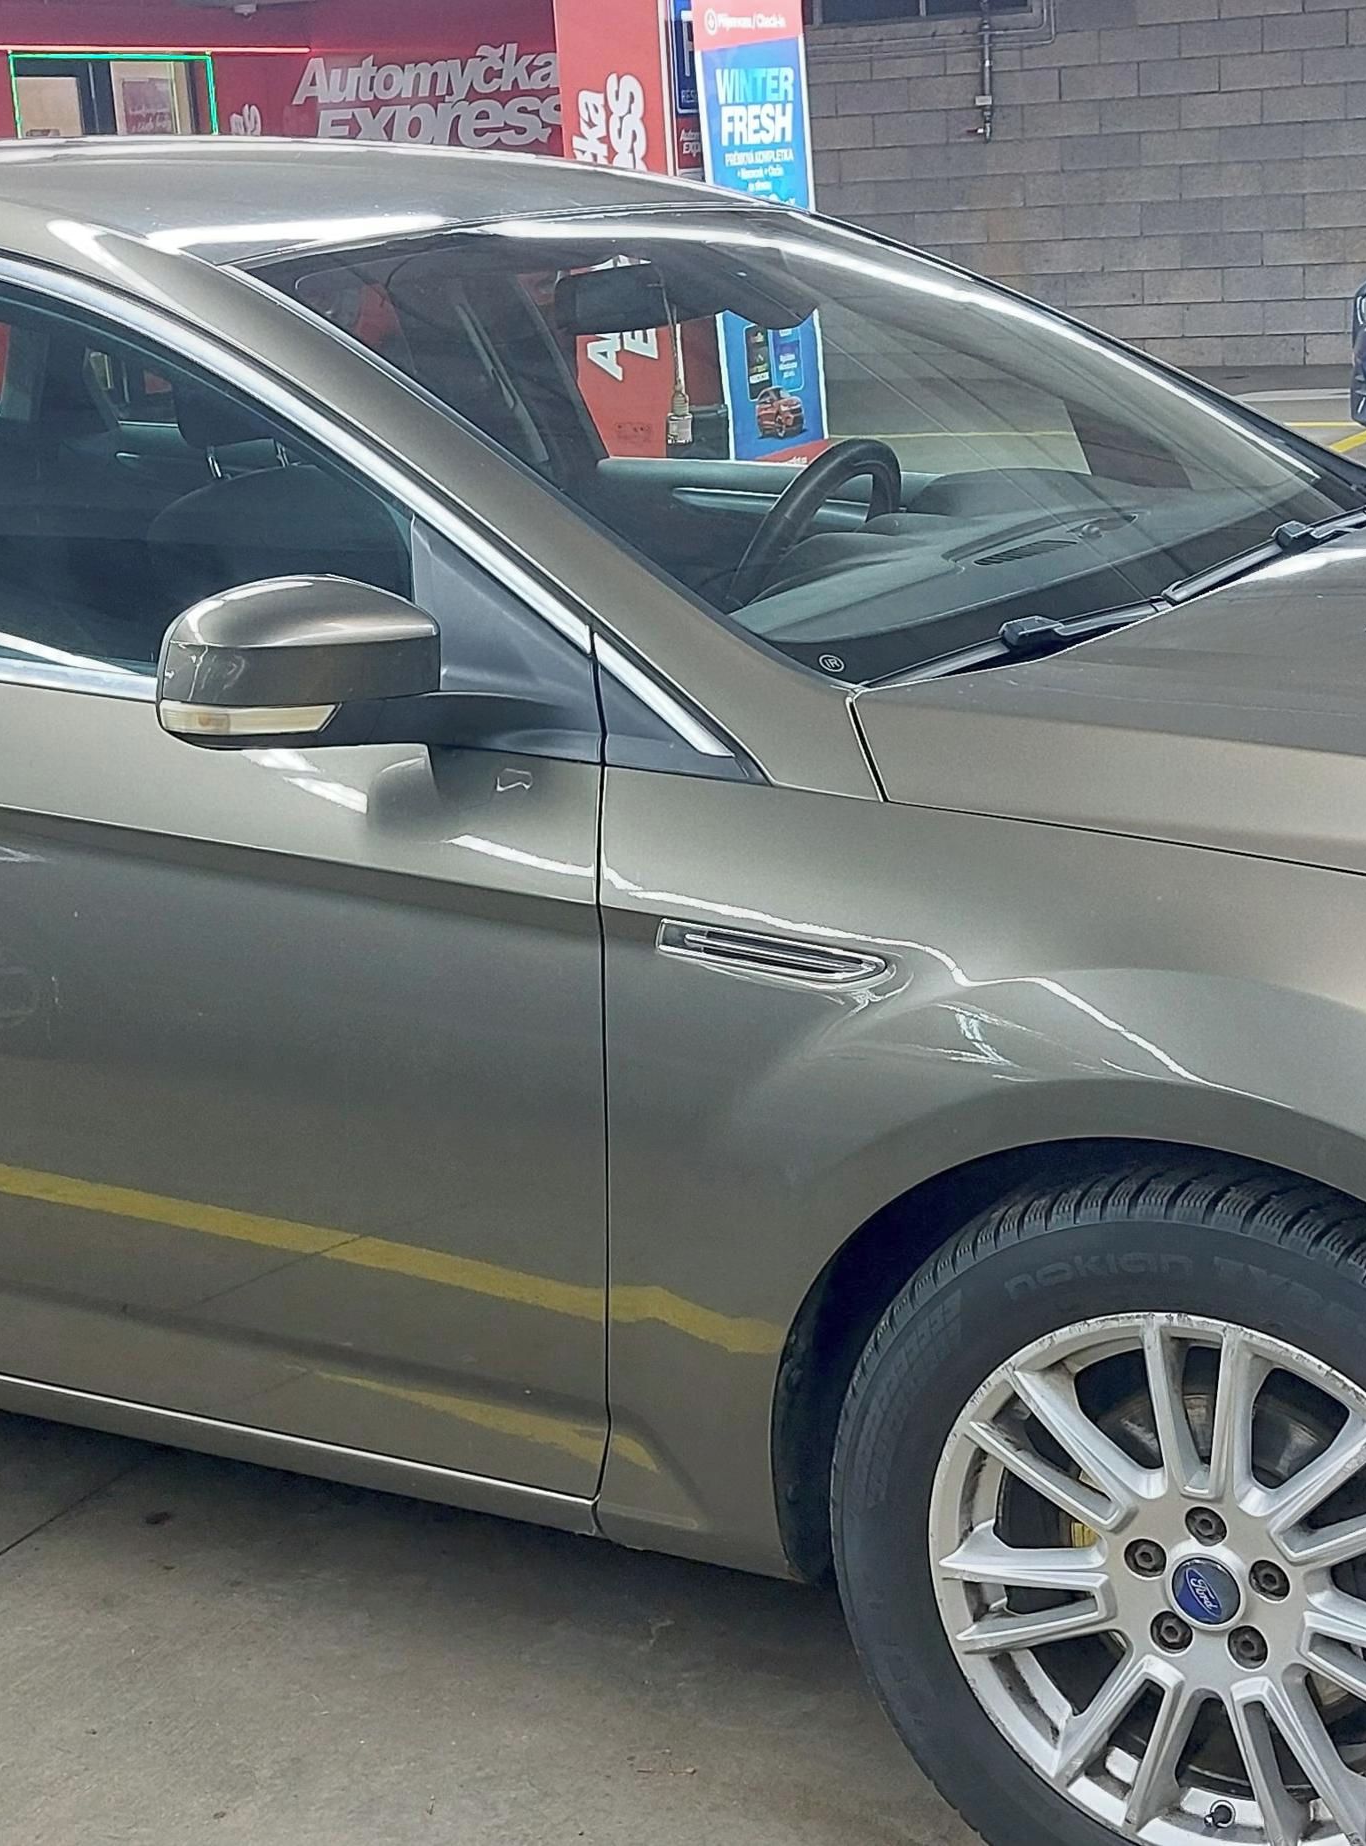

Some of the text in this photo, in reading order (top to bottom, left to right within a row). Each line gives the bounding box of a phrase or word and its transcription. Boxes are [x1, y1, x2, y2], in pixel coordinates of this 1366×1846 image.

[292, 42, 560, 105] Automyčka
[716, 66, 795, 105] WINTER
[720, 103, 793, 146] FRESH
[1190, 1578, 1218, 1610] Ford
